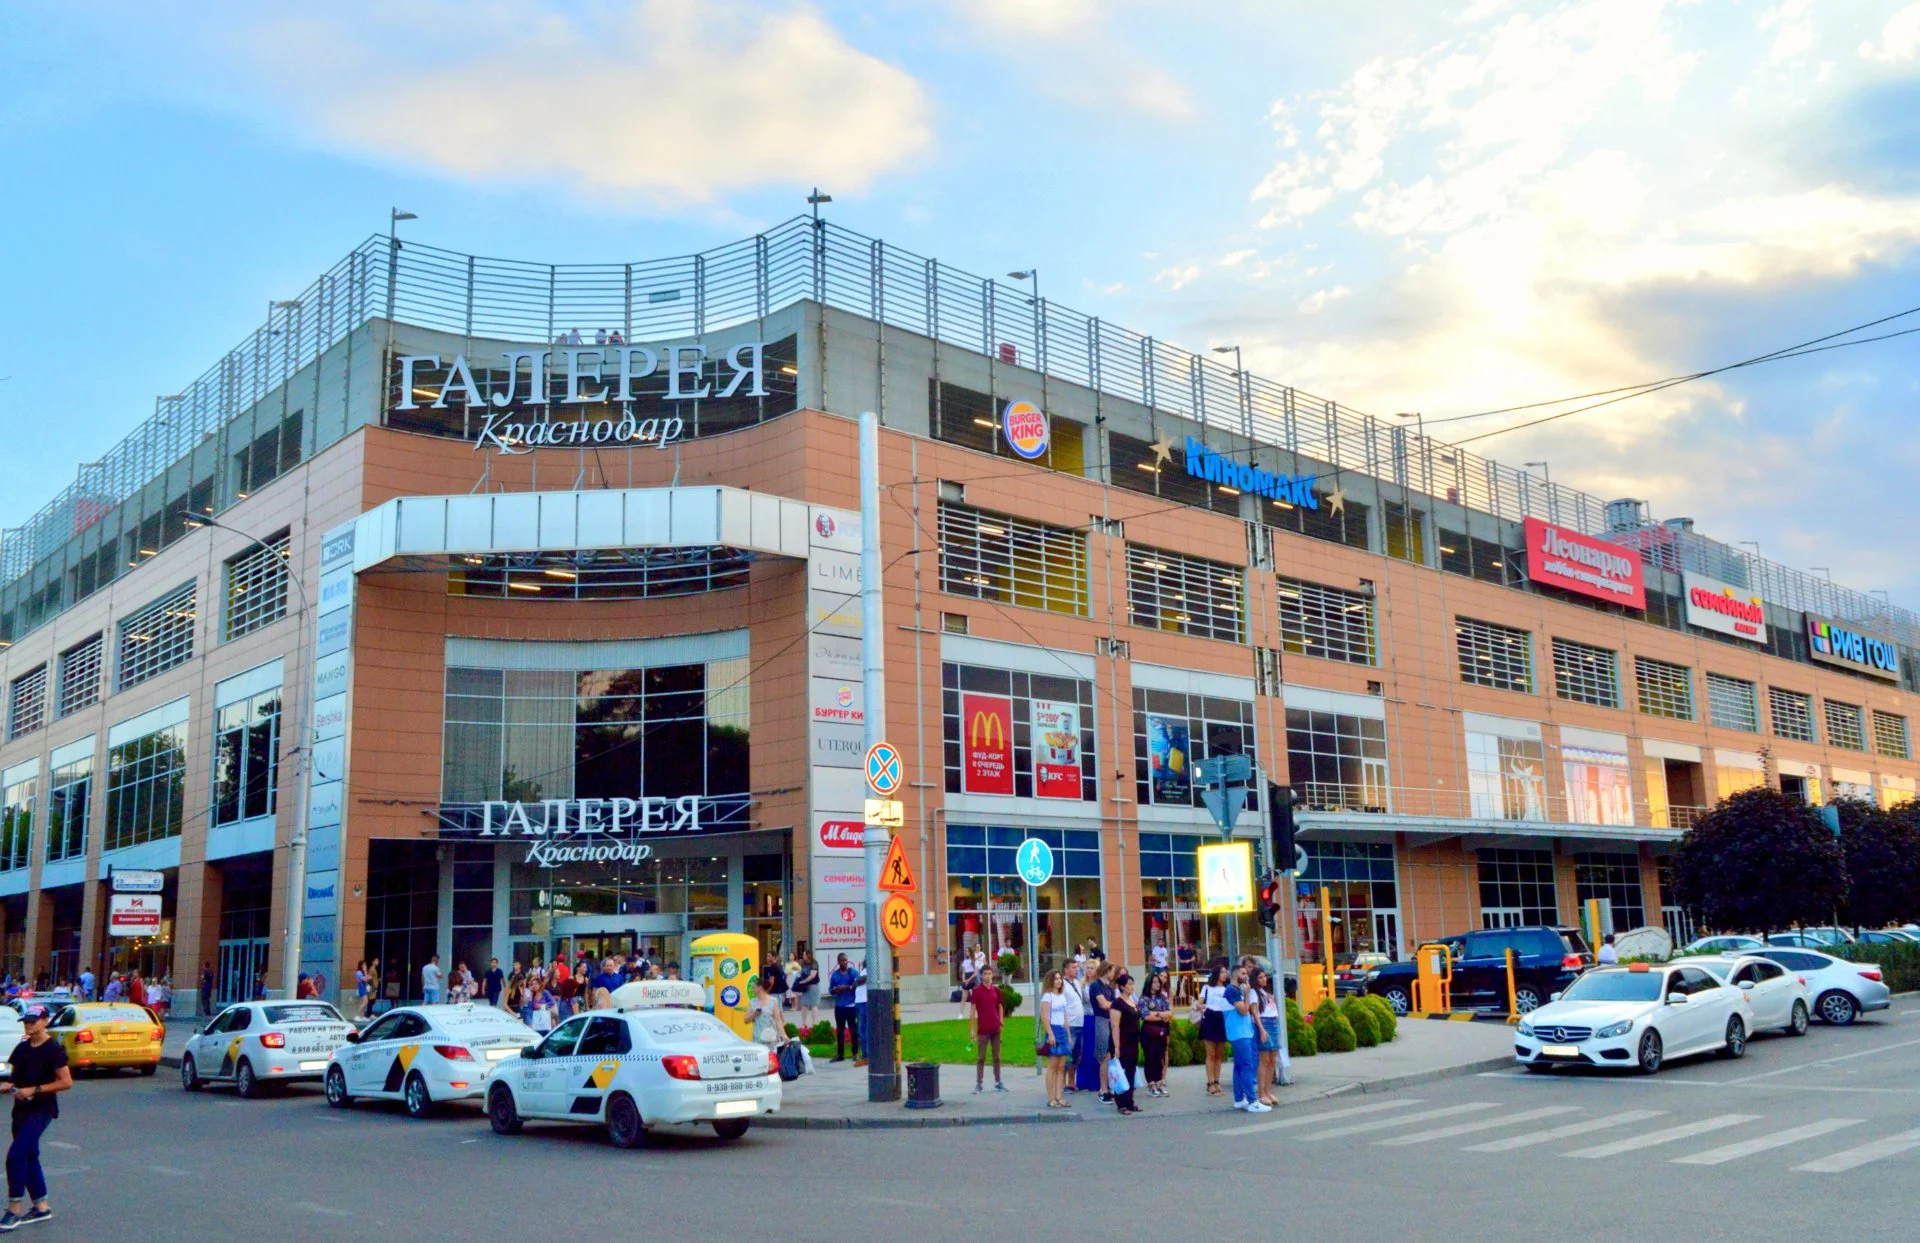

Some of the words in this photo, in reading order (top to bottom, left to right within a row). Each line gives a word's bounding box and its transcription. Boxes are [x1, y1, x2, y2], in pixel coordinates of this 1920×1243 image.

[396, 342, 771, 410] ГАЛЕРЕЯ
[1009, 413, 1041, 426] BURGER
[473, 410, 685, 456] Краснодар
[1011, 423, 1044, 441] KING
[1185, 435, 1319, 510] КИНОМАКС
[1541, 527, 1632, 579] Леонардо
[1830, 625, 1864, 664] РИВ
[1865, 636, 1897, 673] ГОШ
[317, 665, 346, 685] MANGO
[316, 710, 343, 728] Bershka
[815, 707, 849, 719] БУРГЕР
[972, 751, 1004, 761] ФУД-КОРТ
[982, 769, 1001, 778] ЭТАЖ
[479, 795, 703, 836] ГАЛЕРЕЯ
[525, 840, 652, 868] Краснодар
[889, 908, 908, 929] 40
[642, 987, 669, 1000] Яндекс
[702, 1054, 730, 1065] АРЕНДА
[743, 1053, 759, 1062] АВТО
